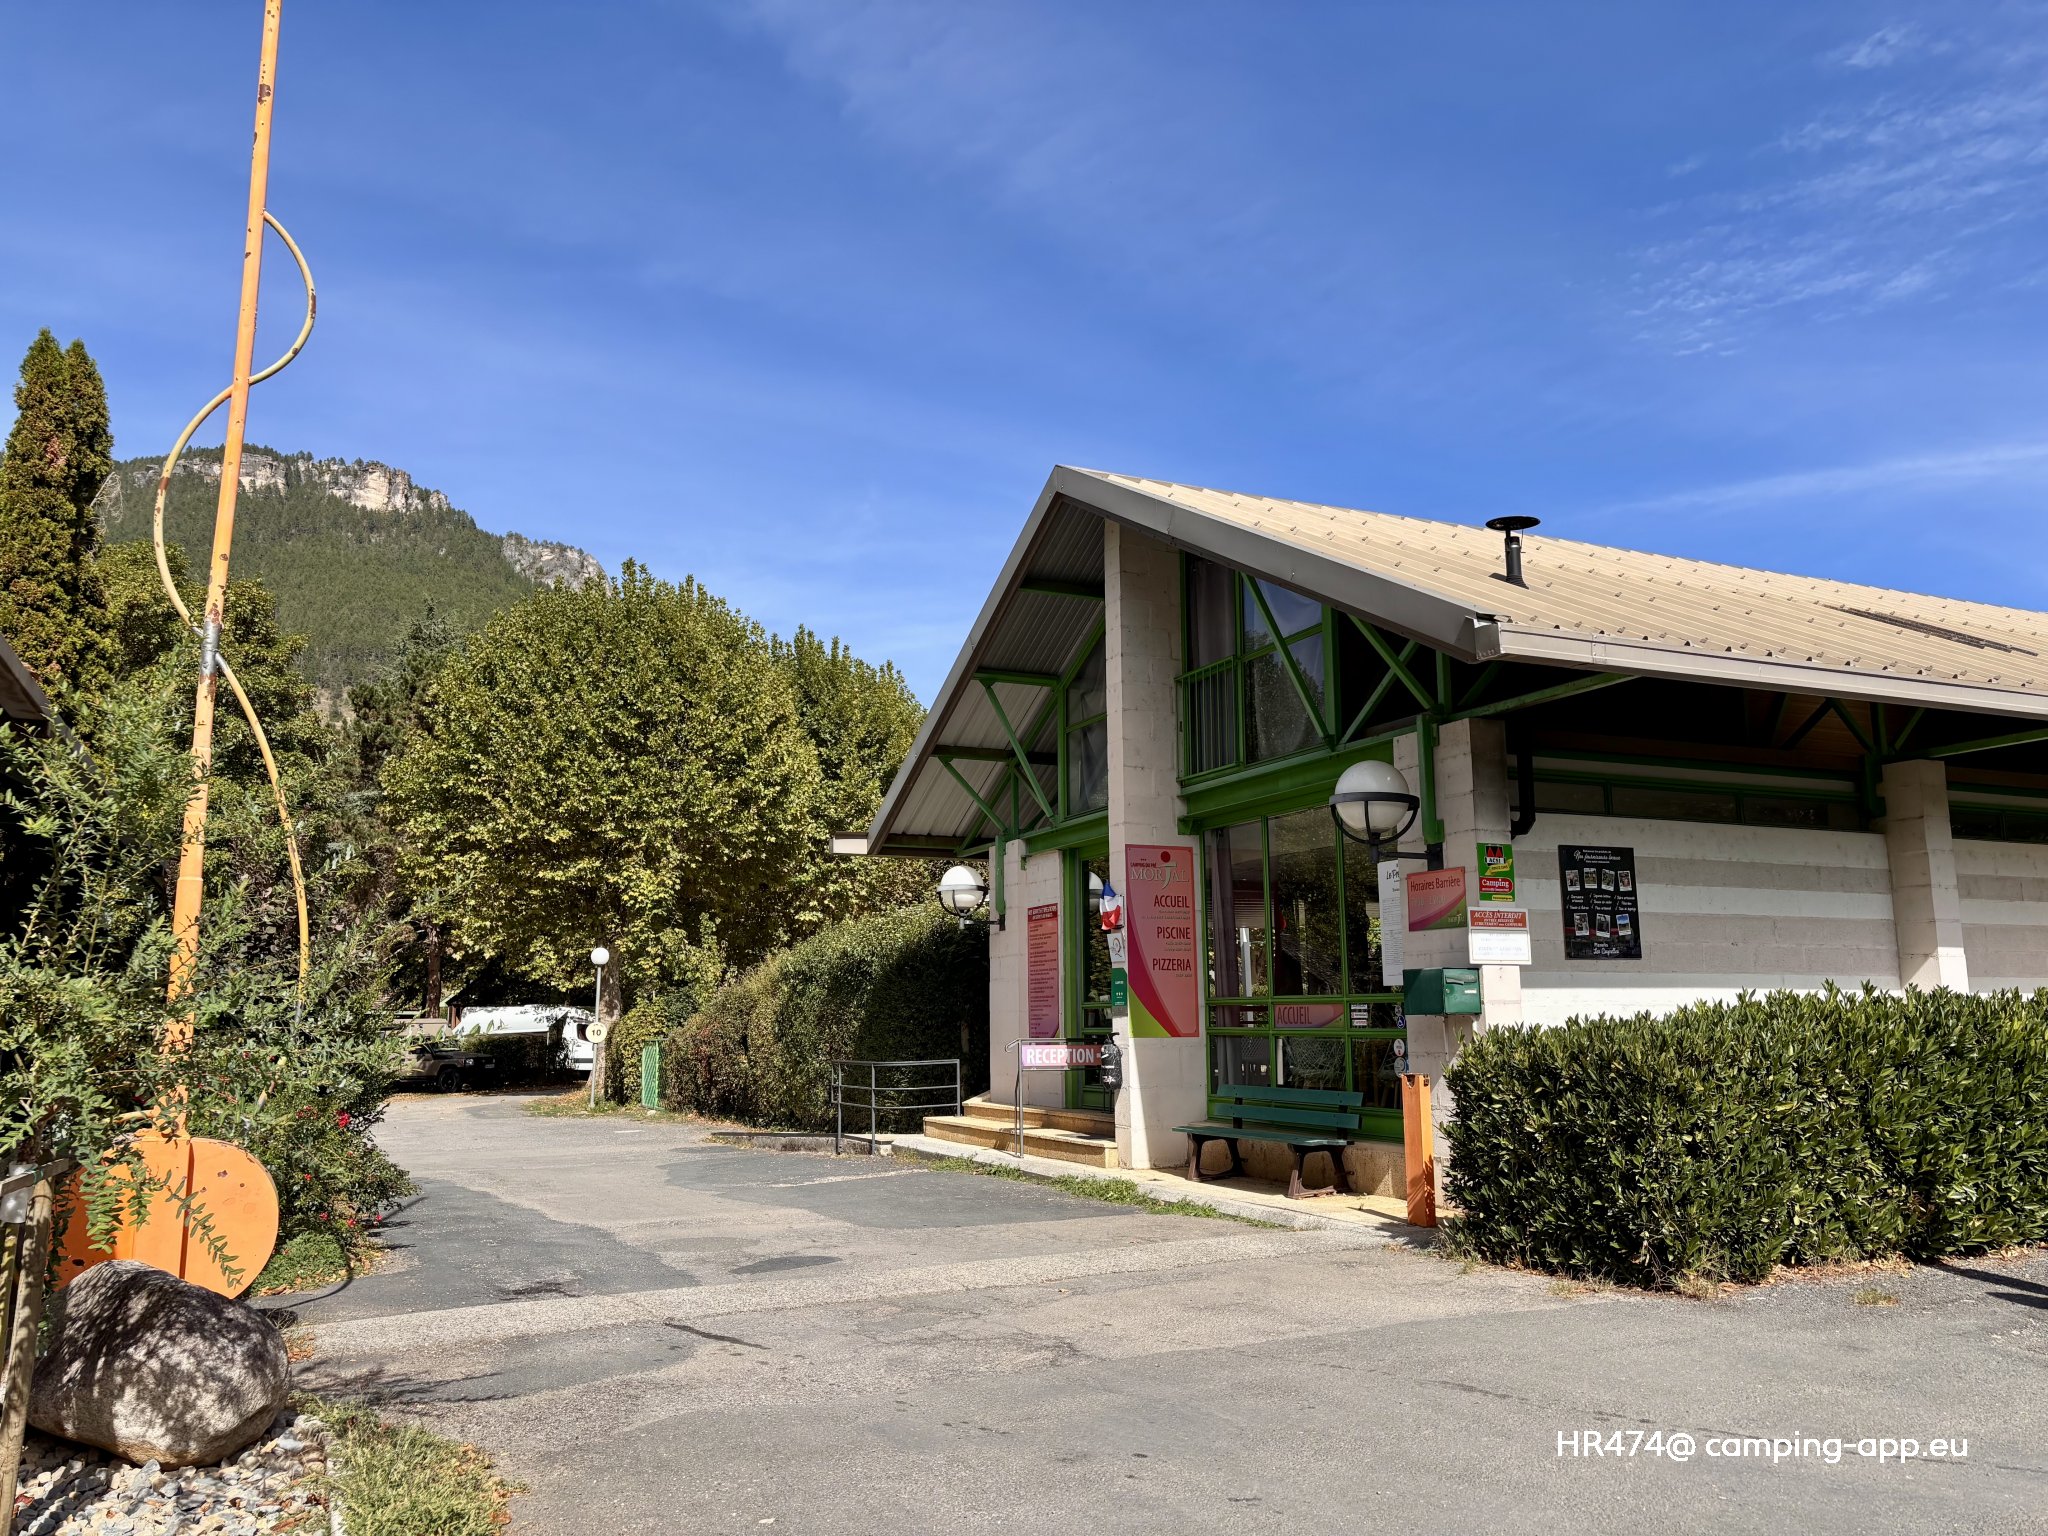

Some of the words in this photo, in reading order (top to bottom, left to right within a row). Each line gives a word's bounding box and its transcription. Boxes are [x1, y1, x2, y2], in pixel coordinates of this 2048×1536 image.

[1410, 880, 1435, 892] Horaires
[1436, 876, 1460, 889] Barrière
[1482, 879, 1509, 888] Camping
[1154, 895, 1189, 908] ACCUEIL
[1157, 926, 1191, 939] PISCINE
[1153, 958, 1191, 971] PIZZERIA
[1277, 1006, 1312, 1025] ACCUEIL
[1026, 1048, 1094, 1064] RECEPTION
